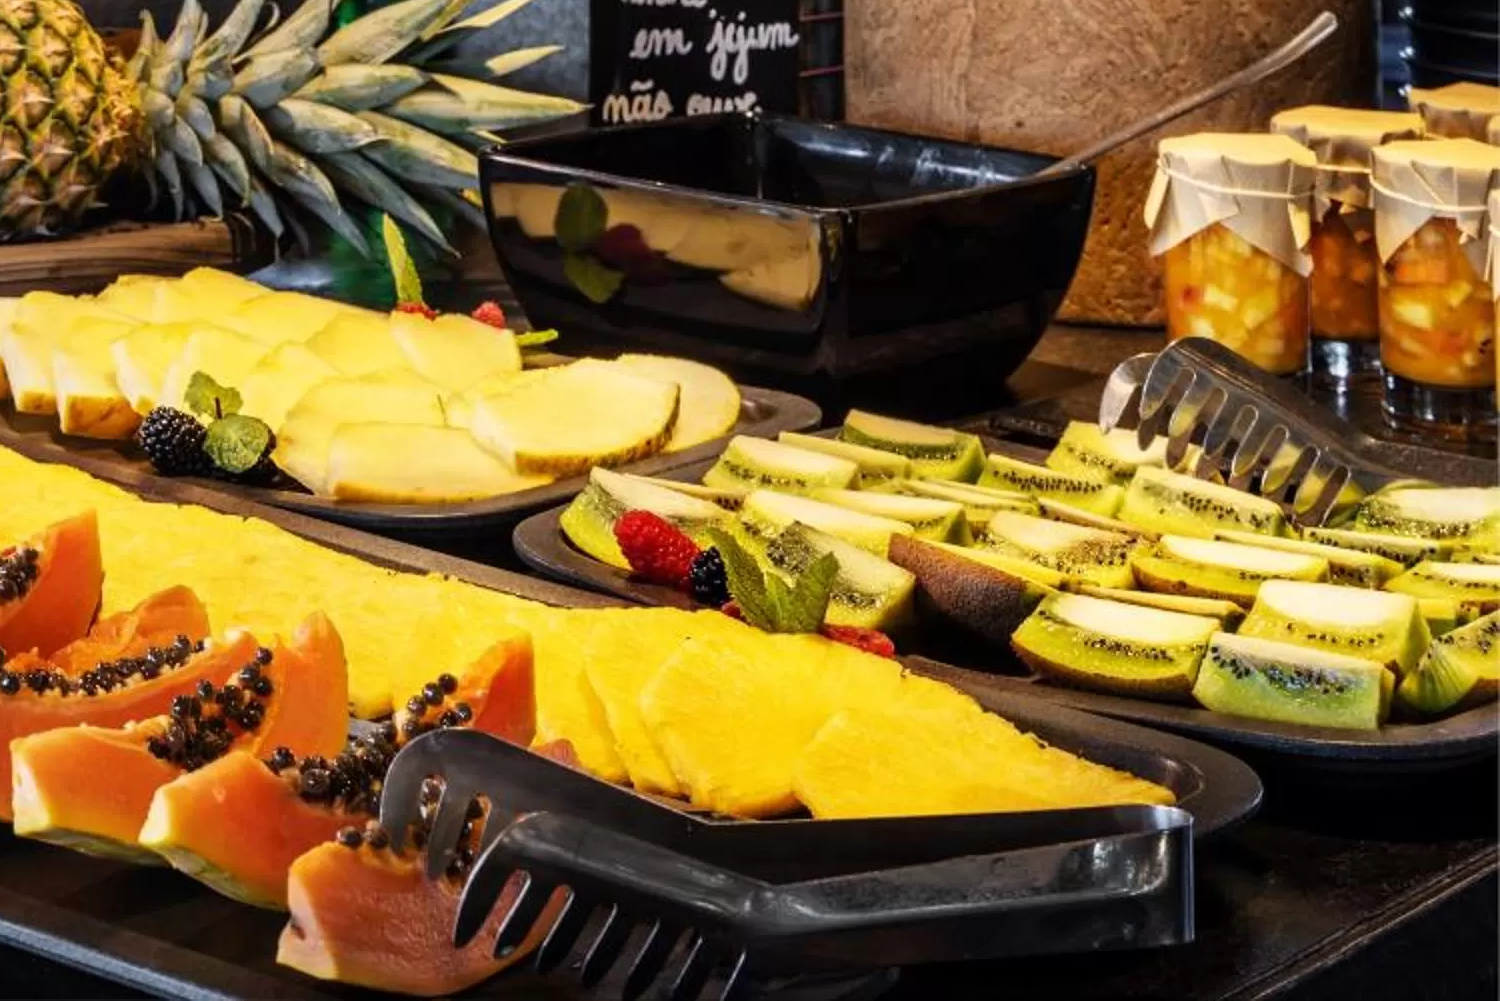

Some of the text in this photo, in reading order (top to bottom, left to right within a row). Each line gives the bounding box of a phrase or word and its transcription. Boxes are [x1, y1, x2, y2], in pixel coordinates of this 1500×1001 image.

[629, 8, 800, 85] em jejum
[602, 79, 674, 124] não
